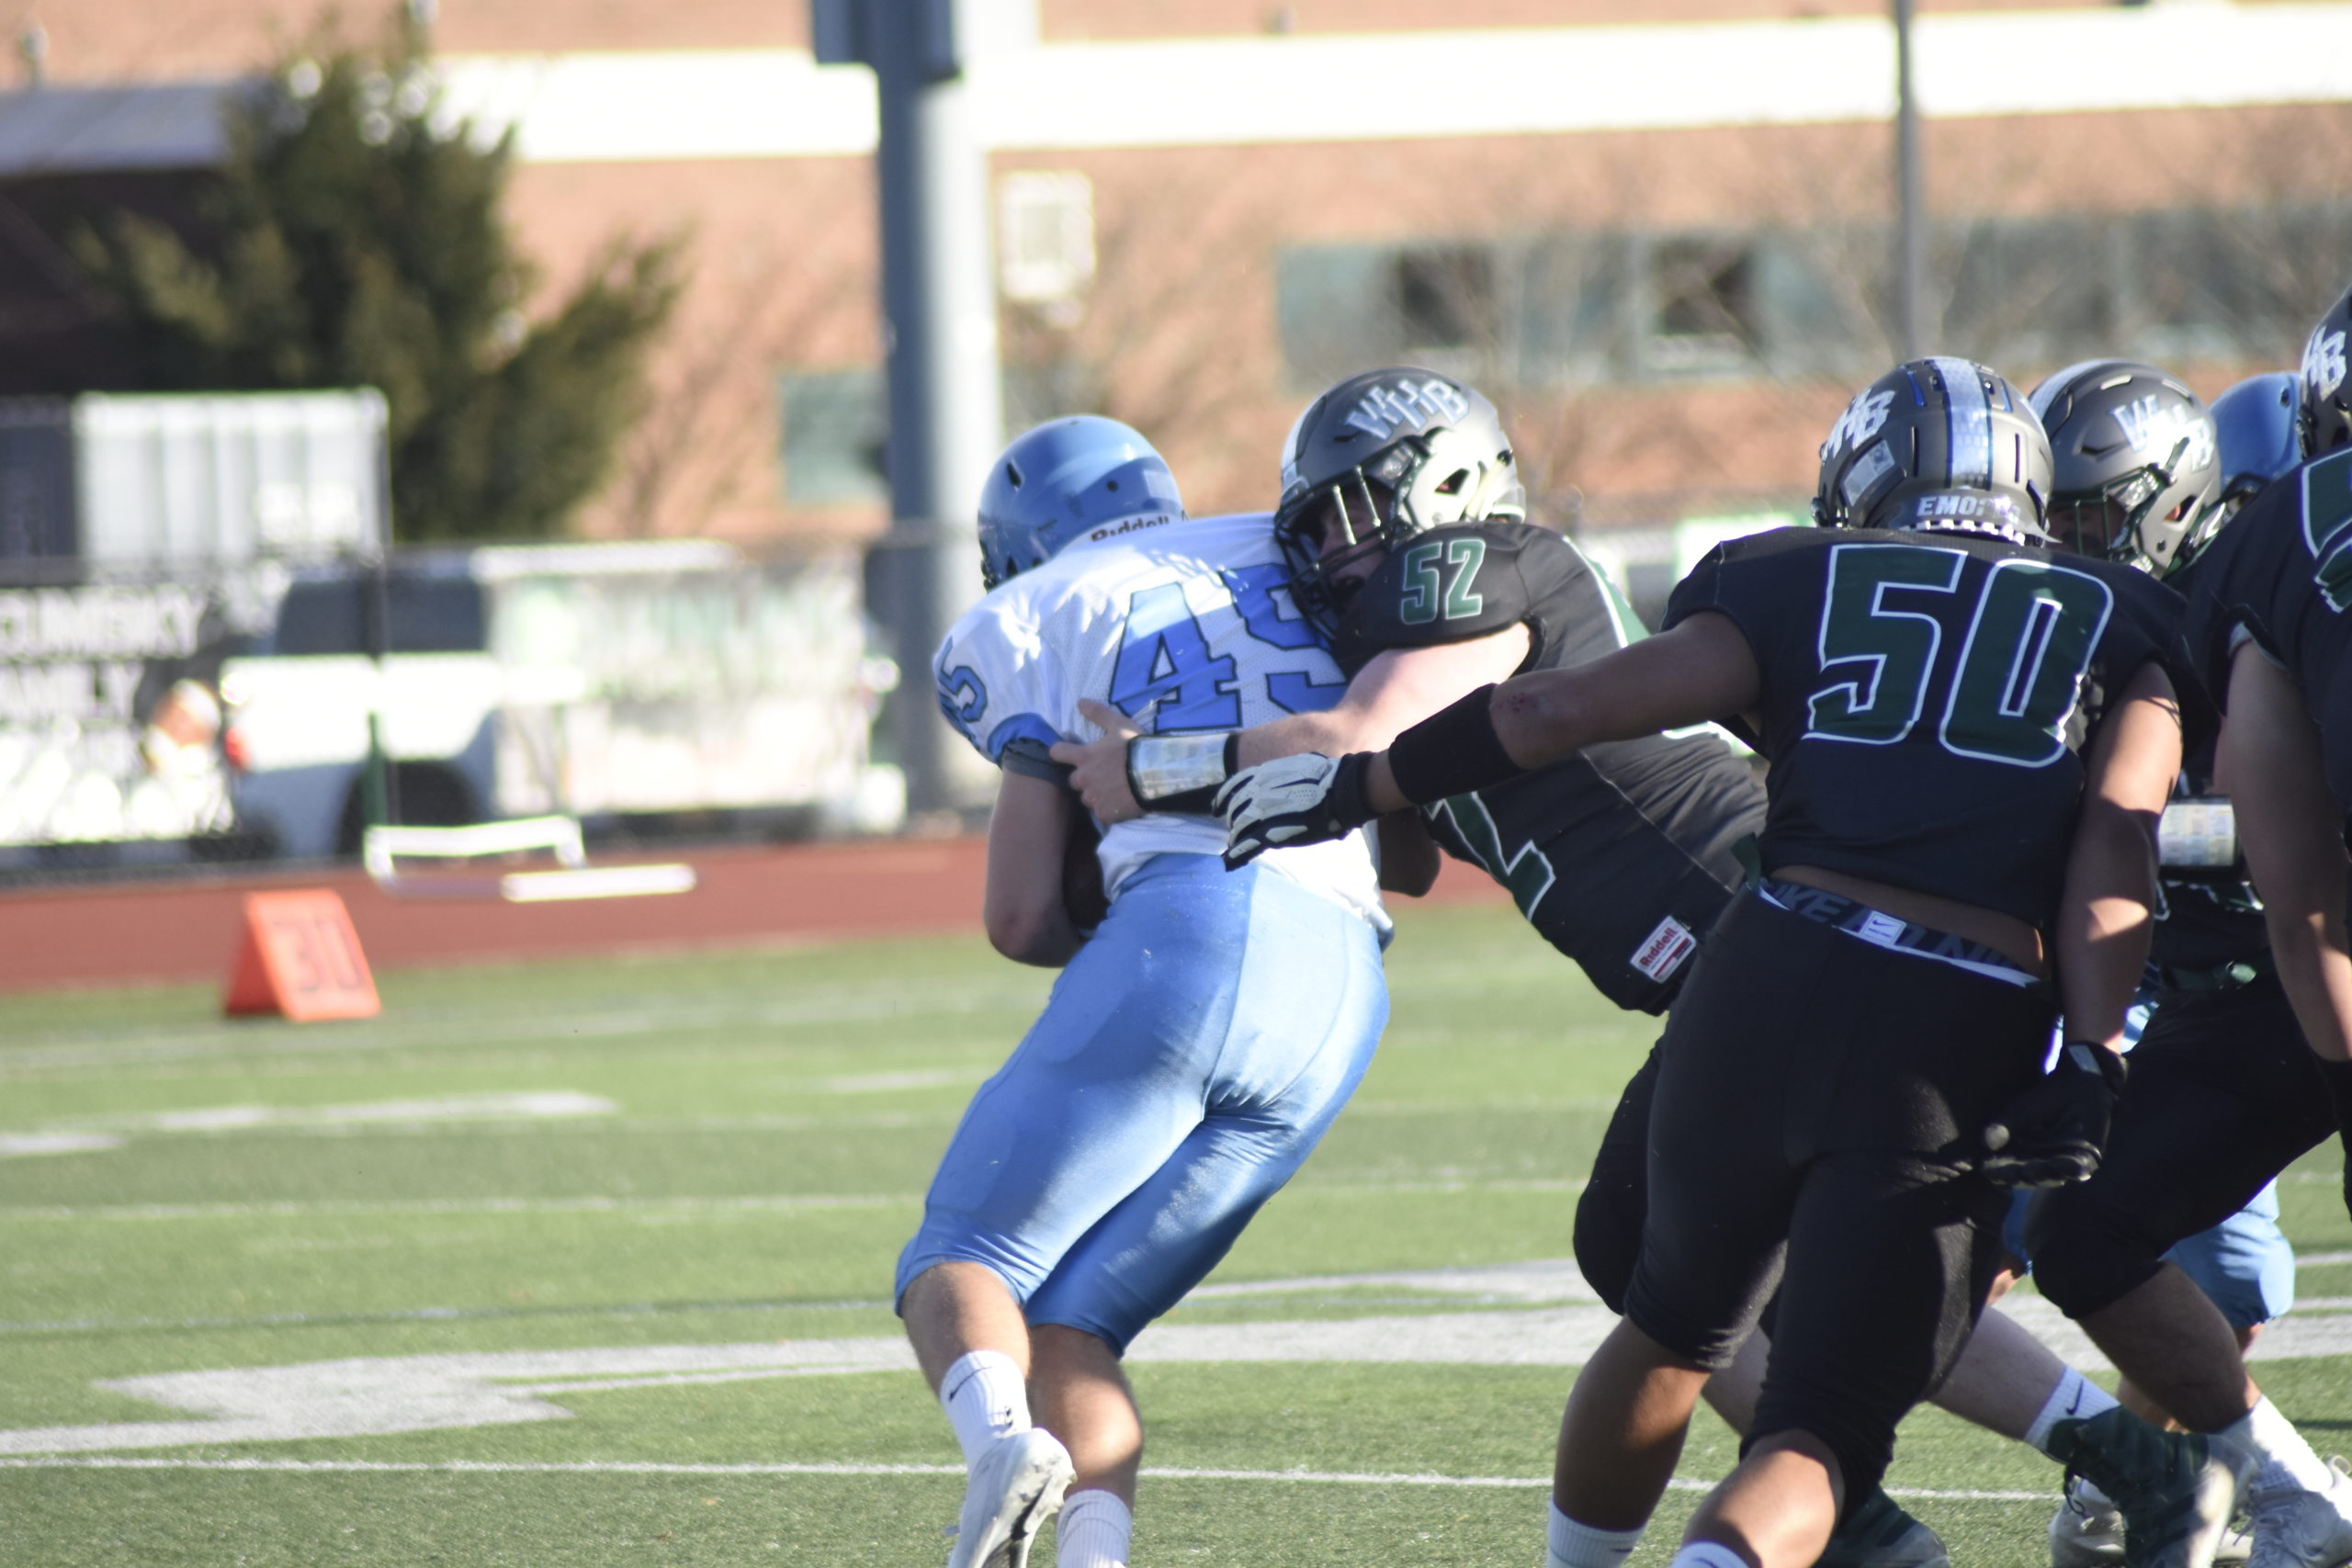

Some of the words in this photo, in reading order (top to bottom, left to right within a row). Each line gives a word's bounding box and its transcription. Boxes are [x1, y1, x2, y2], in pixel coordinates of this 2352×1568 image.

[1344, 378, 1470, 441] WHB
[1400, 535, 1487, 626] 52
[1801, 543, 2114, 768] 50
[1639, 926, 1679, 968] Riddell
